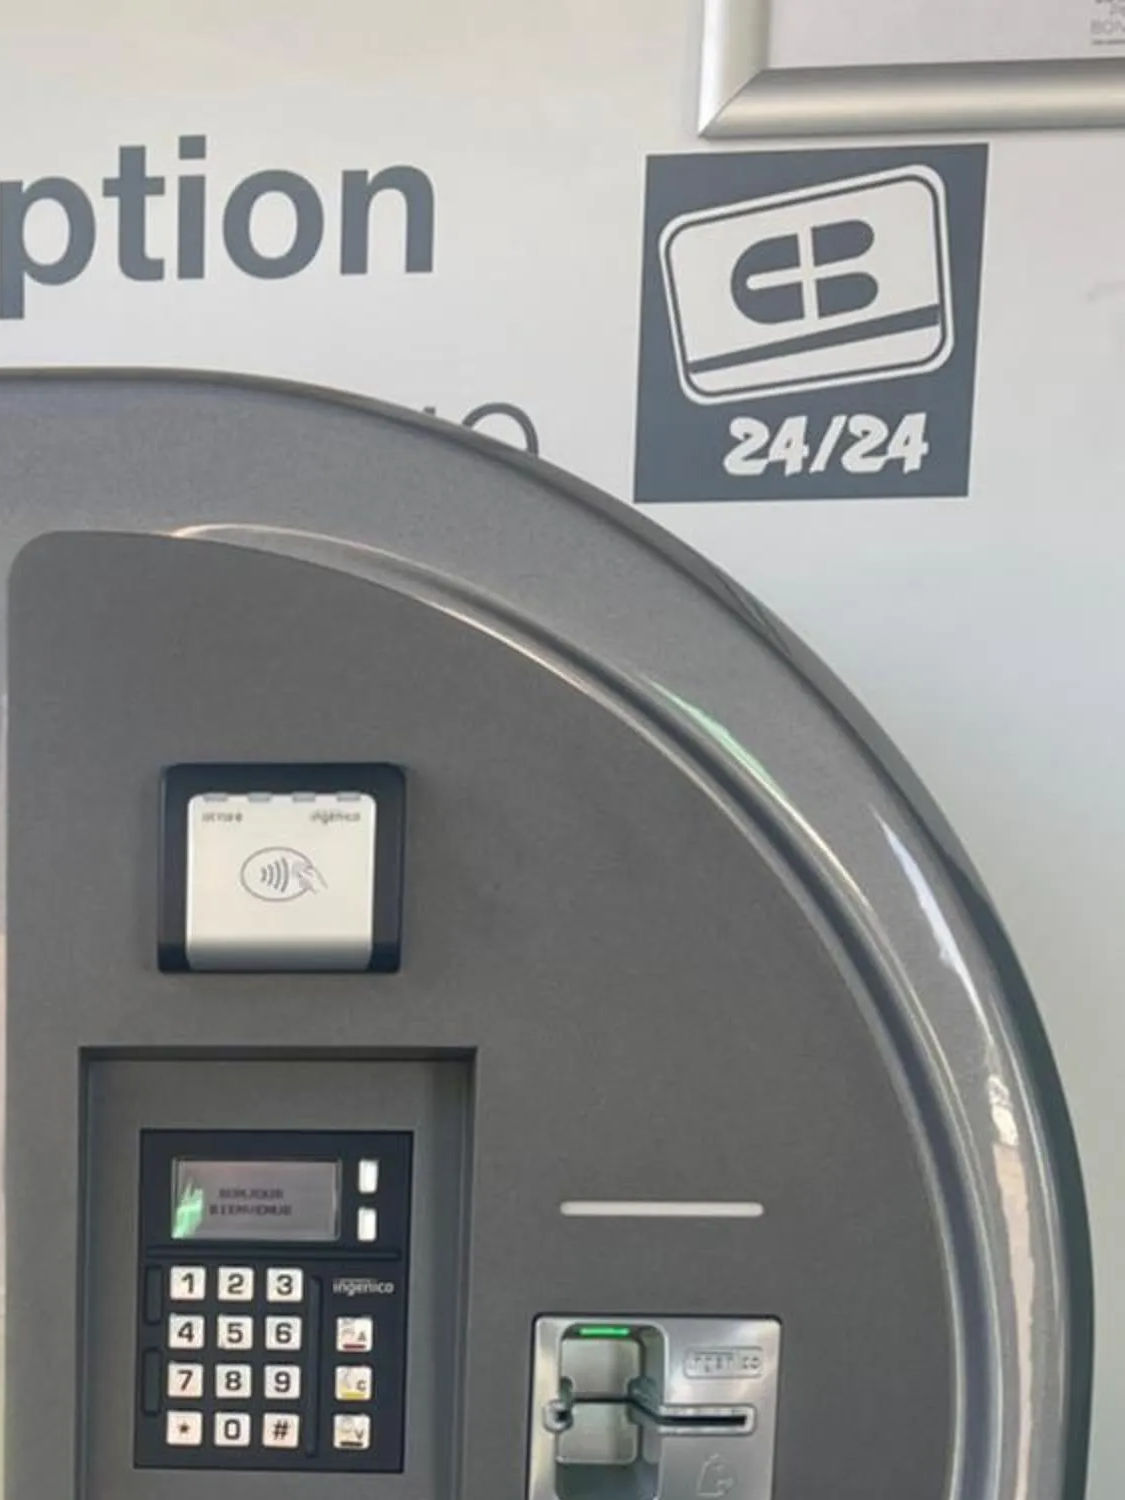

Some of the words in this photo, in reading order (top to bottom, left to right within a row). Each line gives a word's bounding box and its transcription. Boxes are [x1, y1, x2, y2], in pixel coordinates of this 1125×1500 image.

[730, 218, 879, 326] CB
[723, 412, 929, 477] 24/24
[181, 1273, 194, 1294] 1
[227, 1273, 245, 1295] 2
[276, 1274, 293, 1295] 3
[333, 1279, 394, 1296] ingenico
[178, 1322, 194, 1343] 4
[227, 1322, 243, 1344] 5
[275, 1323, 292, 1344] 6
[178, 1369, 194, 1391] 7
[225, 1370, 242, 1391] 8
[274, 1371, 291, 1393] 9
[224, 1418, 241, 1440] 0
